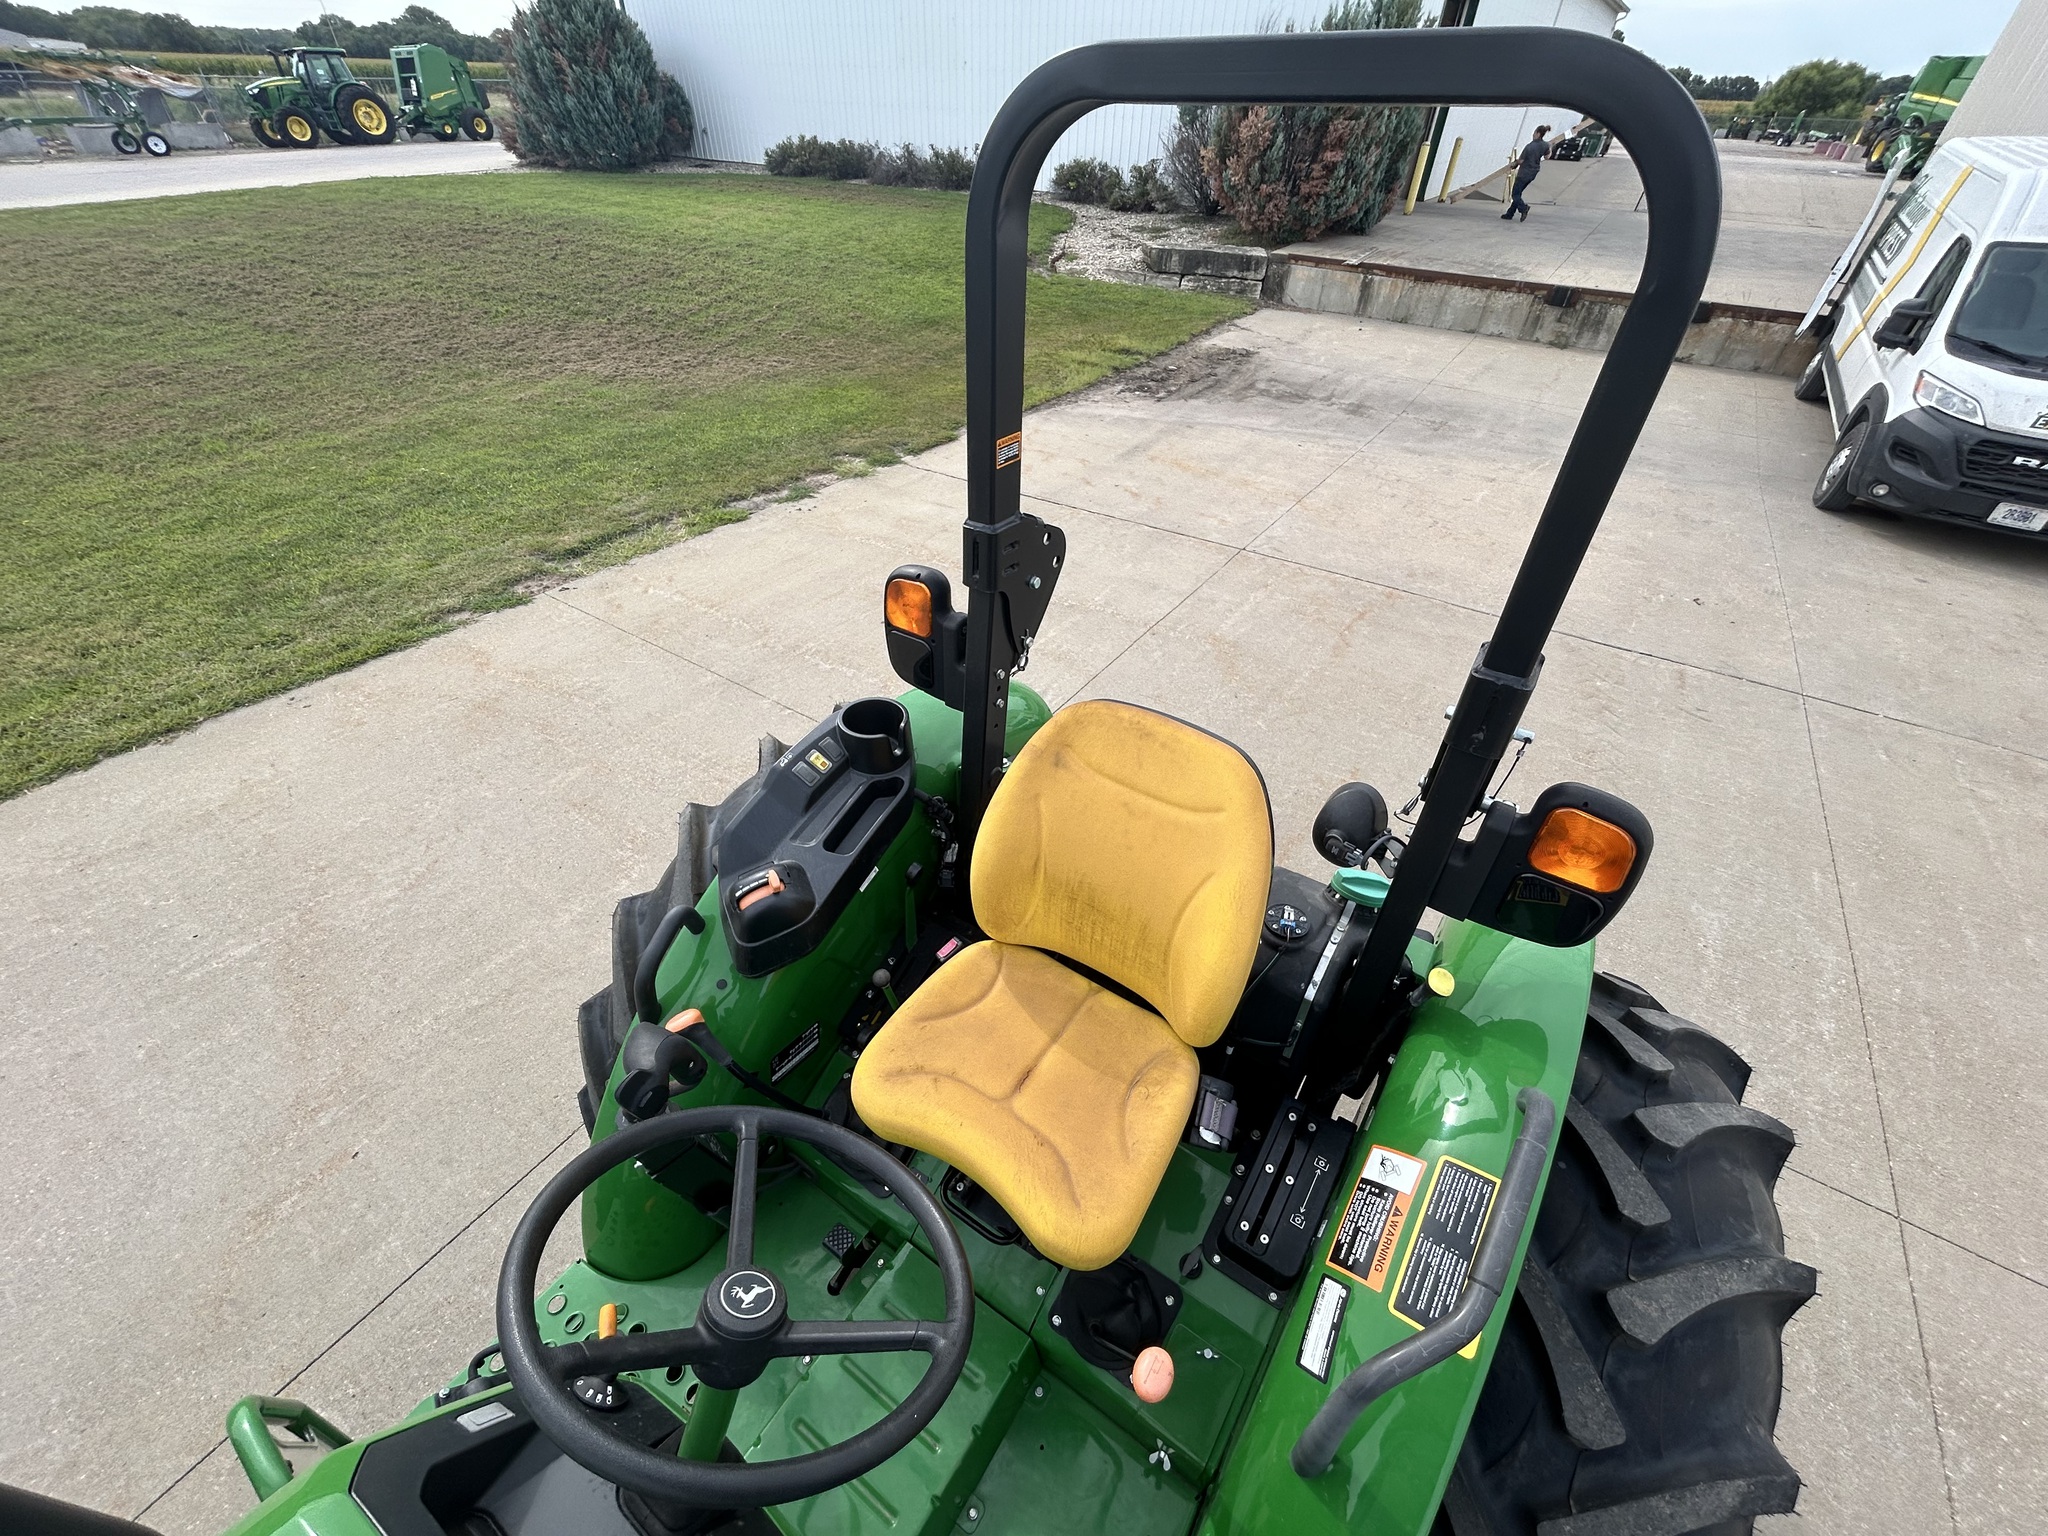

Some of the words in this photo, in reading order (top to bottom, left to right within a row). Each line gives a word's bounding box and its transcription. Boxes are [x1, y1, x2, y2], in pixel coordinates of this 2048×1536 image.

[1383, 1193, 1393, 1210] AVOID
[1372, 1210, 1387, 1242] CRUSHING:
[1374, 1219, 1399, 1274] WARNING
